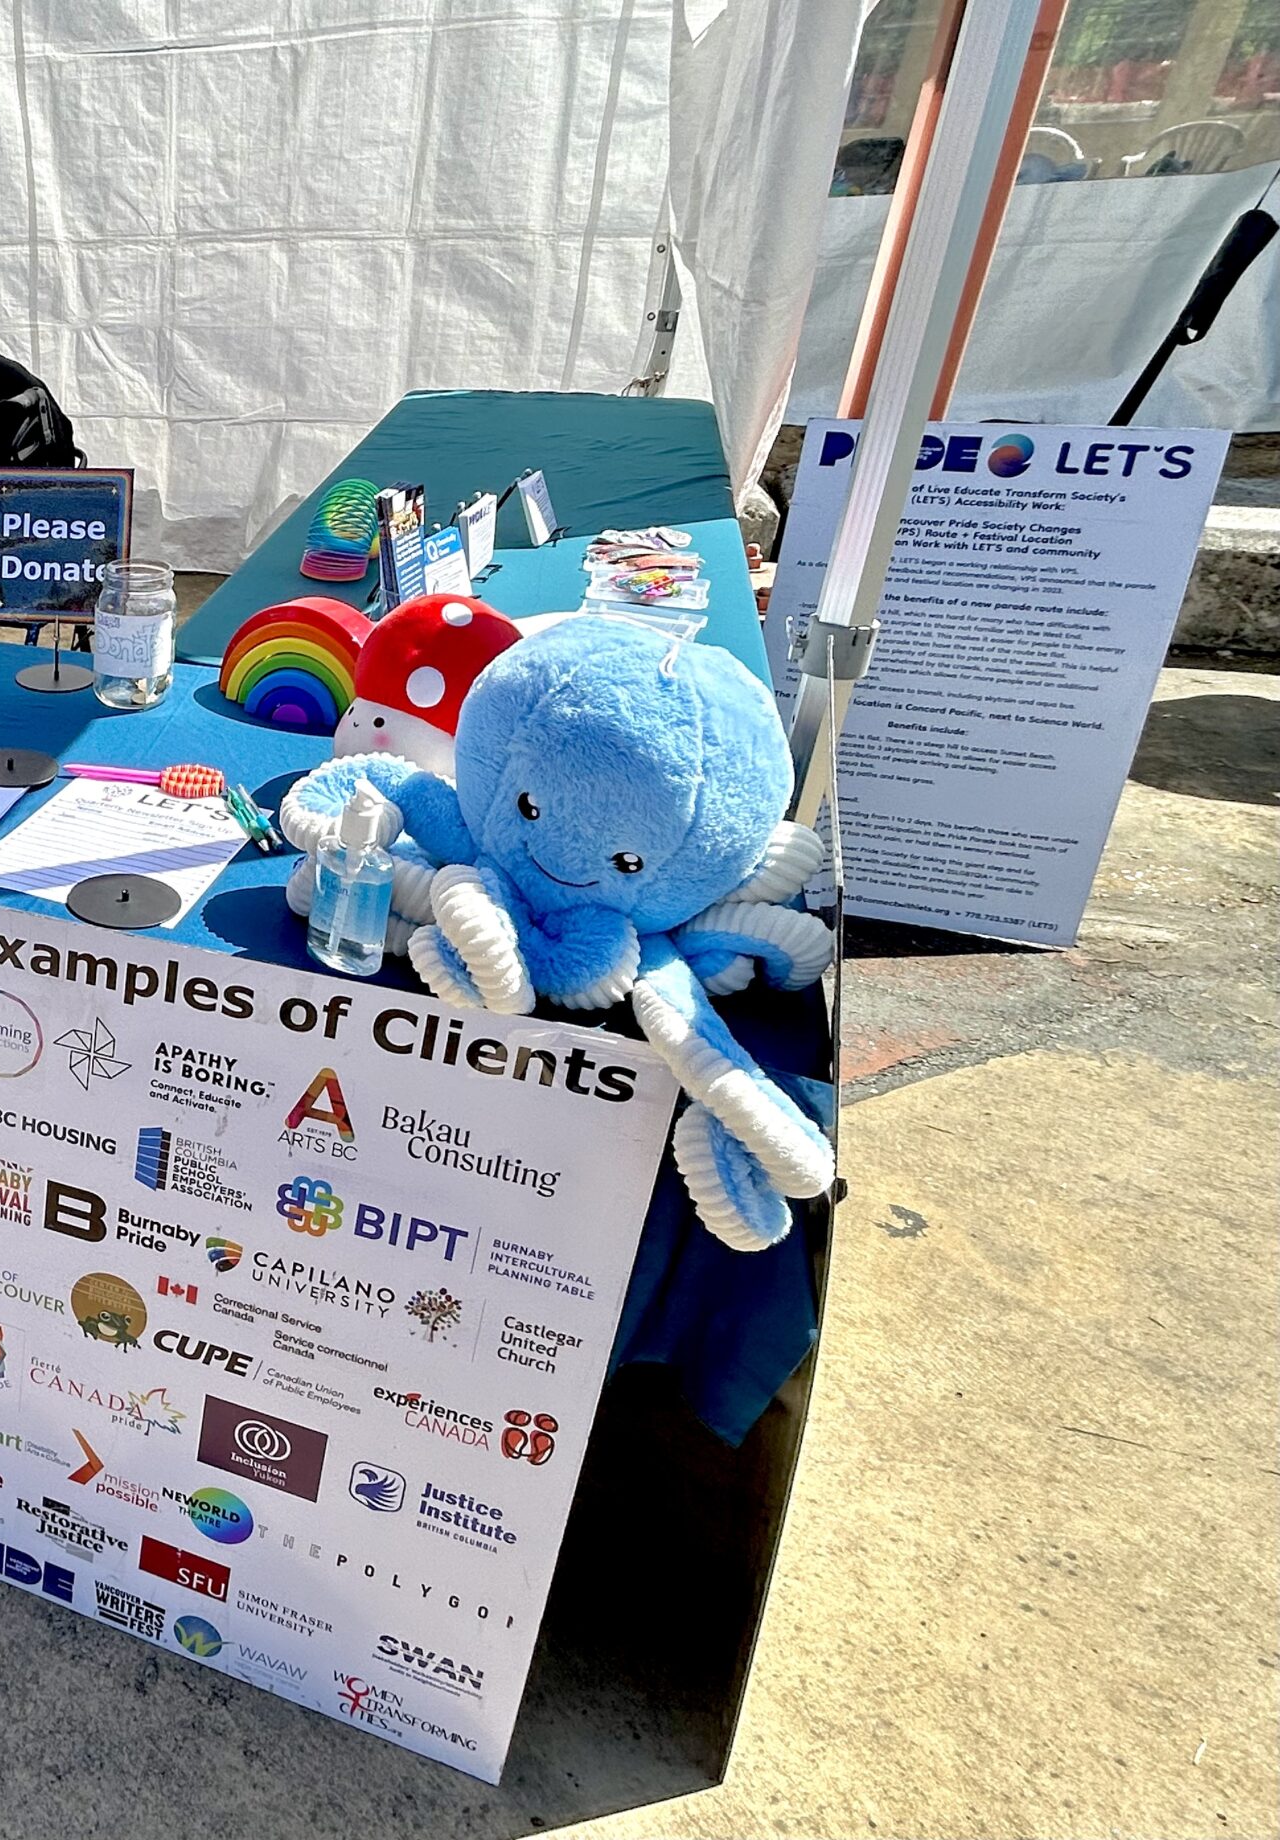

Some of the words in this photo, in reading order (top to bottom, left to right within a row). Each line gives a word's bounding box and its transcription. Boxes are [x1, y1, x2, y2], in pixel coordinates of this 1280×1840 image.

[1056, 441, 1195, 479] LET'S
[911, 484, 925, 494] of
[927, 485, 951, 495] Live
[953, 486, 1001, 497] Educate
[1005, 488, 1067, 500] Transform
[1071, 491, 1126, 504] Society's
[954, 497, 1027, 511] Accessibility
[1031, 500, 1066, 512] Work:
[2, 513, 106, 540] Please
[899, 517, 946, 528] ncouver
[949, 518, 979, 530] Pride
[982, 520, 1026, 533] Society
[1029, 523, 1082, 535] Changes
[925, 528, 958, 539] Route
[973, 531, 1018, 543] Festival
[1022, 534, 1073, 546] Location
[912, 538, 941, 549] Work
[944, 540, 969, 550] with
[972, 543, 1003, 553] LET'S
[1006, 545, 1029, 554] and
[1032, 546, 1101, 560] community
[884, 593, 901, 602] the
[903, 594, 945, 606] benefits
[947, 598, 959, 607] of
[994, 602, 1032, 613] parade
[1034, 604, 1063, 613] route
[1066, 606, 1110, 617] include:
[852, 698, 892, 711] location
[895, 702, 903, 711] is
[905, 703, 947, 716] Concord
[949, 707, 985, 720] Pacific,
[988, 712, 1012, 722] next
[1015, 715, 1026, 723] to
[1028, 715, 1069, 727] Science
[1072, 719, 1105, 730] World.
[887, 720, 928, 733] Benefits
[930, 725, 969, 737] include:
[127, 807, 185, 823] Newsletter
[137, 794, 230, 821] LET'S
[154, 1041, 239, 1072] APATHY
[279, 995, 353, 1039] of
[372, 1008, 638, 1103] Clients
[154, 1057, 174, 1075] IS
[149, 1091, 174, 1106] and
[176, 1096, 218, 1115] Activate.
[198, 1090, 242, 1110] Educate
[21, 1115, 117, 1155] HOUSING
[381, 1105, 470, 1149] Bakau
[175, 1147, 237, 1171] COLUMBIA
[176, 1137, 221, 1156] BRITISH
[277, 1129, 326, 1154] ARTS
[331, 1141, 359, 1162] BC
[173, 1165, 223, 1185] SCHOOL
[174, 1156, 217, 1174] PUBLIC
[407, 1137, 561, 1198] Consulting
[171, 1182, 253, 1212] ASSOCIATION
[172, 1174, 247, 1200] EMPLOYERS'
[43, 1179, 107, 1242] B
[116, 1226, 167, 1252] Pride
[118, 1208, 201, 1247] Burnaby
[354, 1203, 469, 1262] BIPT
[493, 1239, 554, 1262] BURNABY
[2, 1270, 19, 1283] OF
[253, 1252, 395, 1304] CAPILANO
[488, 1264, 552, 1289] PLANNING
[555, 1282, 595, 1301] TABLE
[490, 1252, 592, 1286] INTERCULTURAL
[252, 1269, 390, 1319] UNIVERSITY
[213, 1303, 255, 1323] Canada
[214, 1293, 278, 1321] Correctional
[281, 1313, 322, 1333] Service
[500, 1331, 559, 1358] United
[504, 1315, 583, 1349] Castlegar
[153, 1329, 254, 1377] CUPE
[273, 1340, 315, 1360] Canada
[274, 1329, 315, 1350] Service
[317, 1342, 388, 1372] correctionnel
[497, 1346, 556, 1374] Church
[29, 1367, 145, 1420] CANADA
[263, 1376, 275, 1386] of
[275, 1380, 306, 1397] Public
[306, 1390, 362, 1415] Employees
[267, 1367, 313, 1389] Canadian
[315, 1382, 345, 1399] Union
[111, 1413, 143, 1431] pride
[373, 1385, 494, 1433] experiences
[404, 1410, 489, 1451] CANADA
[230, 1451, 287, 1479] Inclusion
[252, 1469, 286, 1487] Yukon
[95, 1481, 159, 1513] possible
[104, 1471, 160, 1501] mission
[421, 1482, 503, 1521] Justice
[161, 1487, 241, 1524] NEWORLD
[178, 1505, 222, 1529] THEATRE
[16, 1497, 129, 1551] Restorative
[36, 1519, 104, 1553] Justice
[417, 1520, 450, 1538] BRITISH
[453, 1532, 498, 1554] COLUMBIA
[419, 1500, 518, 1545] Institute
[257, 1524, 322, 1559] THE
[95, 1580, 141, 1604] VANCOUVER
[176, 1567, 225, 1599] SFU
[95, 1589, 166, 1628] WRITERS
[236, 1600, 315, 1638] UNIVERSITY
[238, 1589, 279, 1611] SIMON
[282, 1606, 334, 1633] FRASER
[128, 1618, 163, 1640] FEST
[238, 1644, 308, 1682] WAVAW
[376, 1635, 484, 1690] SWAN
[333, 1669, 404, 1707] WOMEN
[365, 1698, 478, 1751] TRANSFORMING
